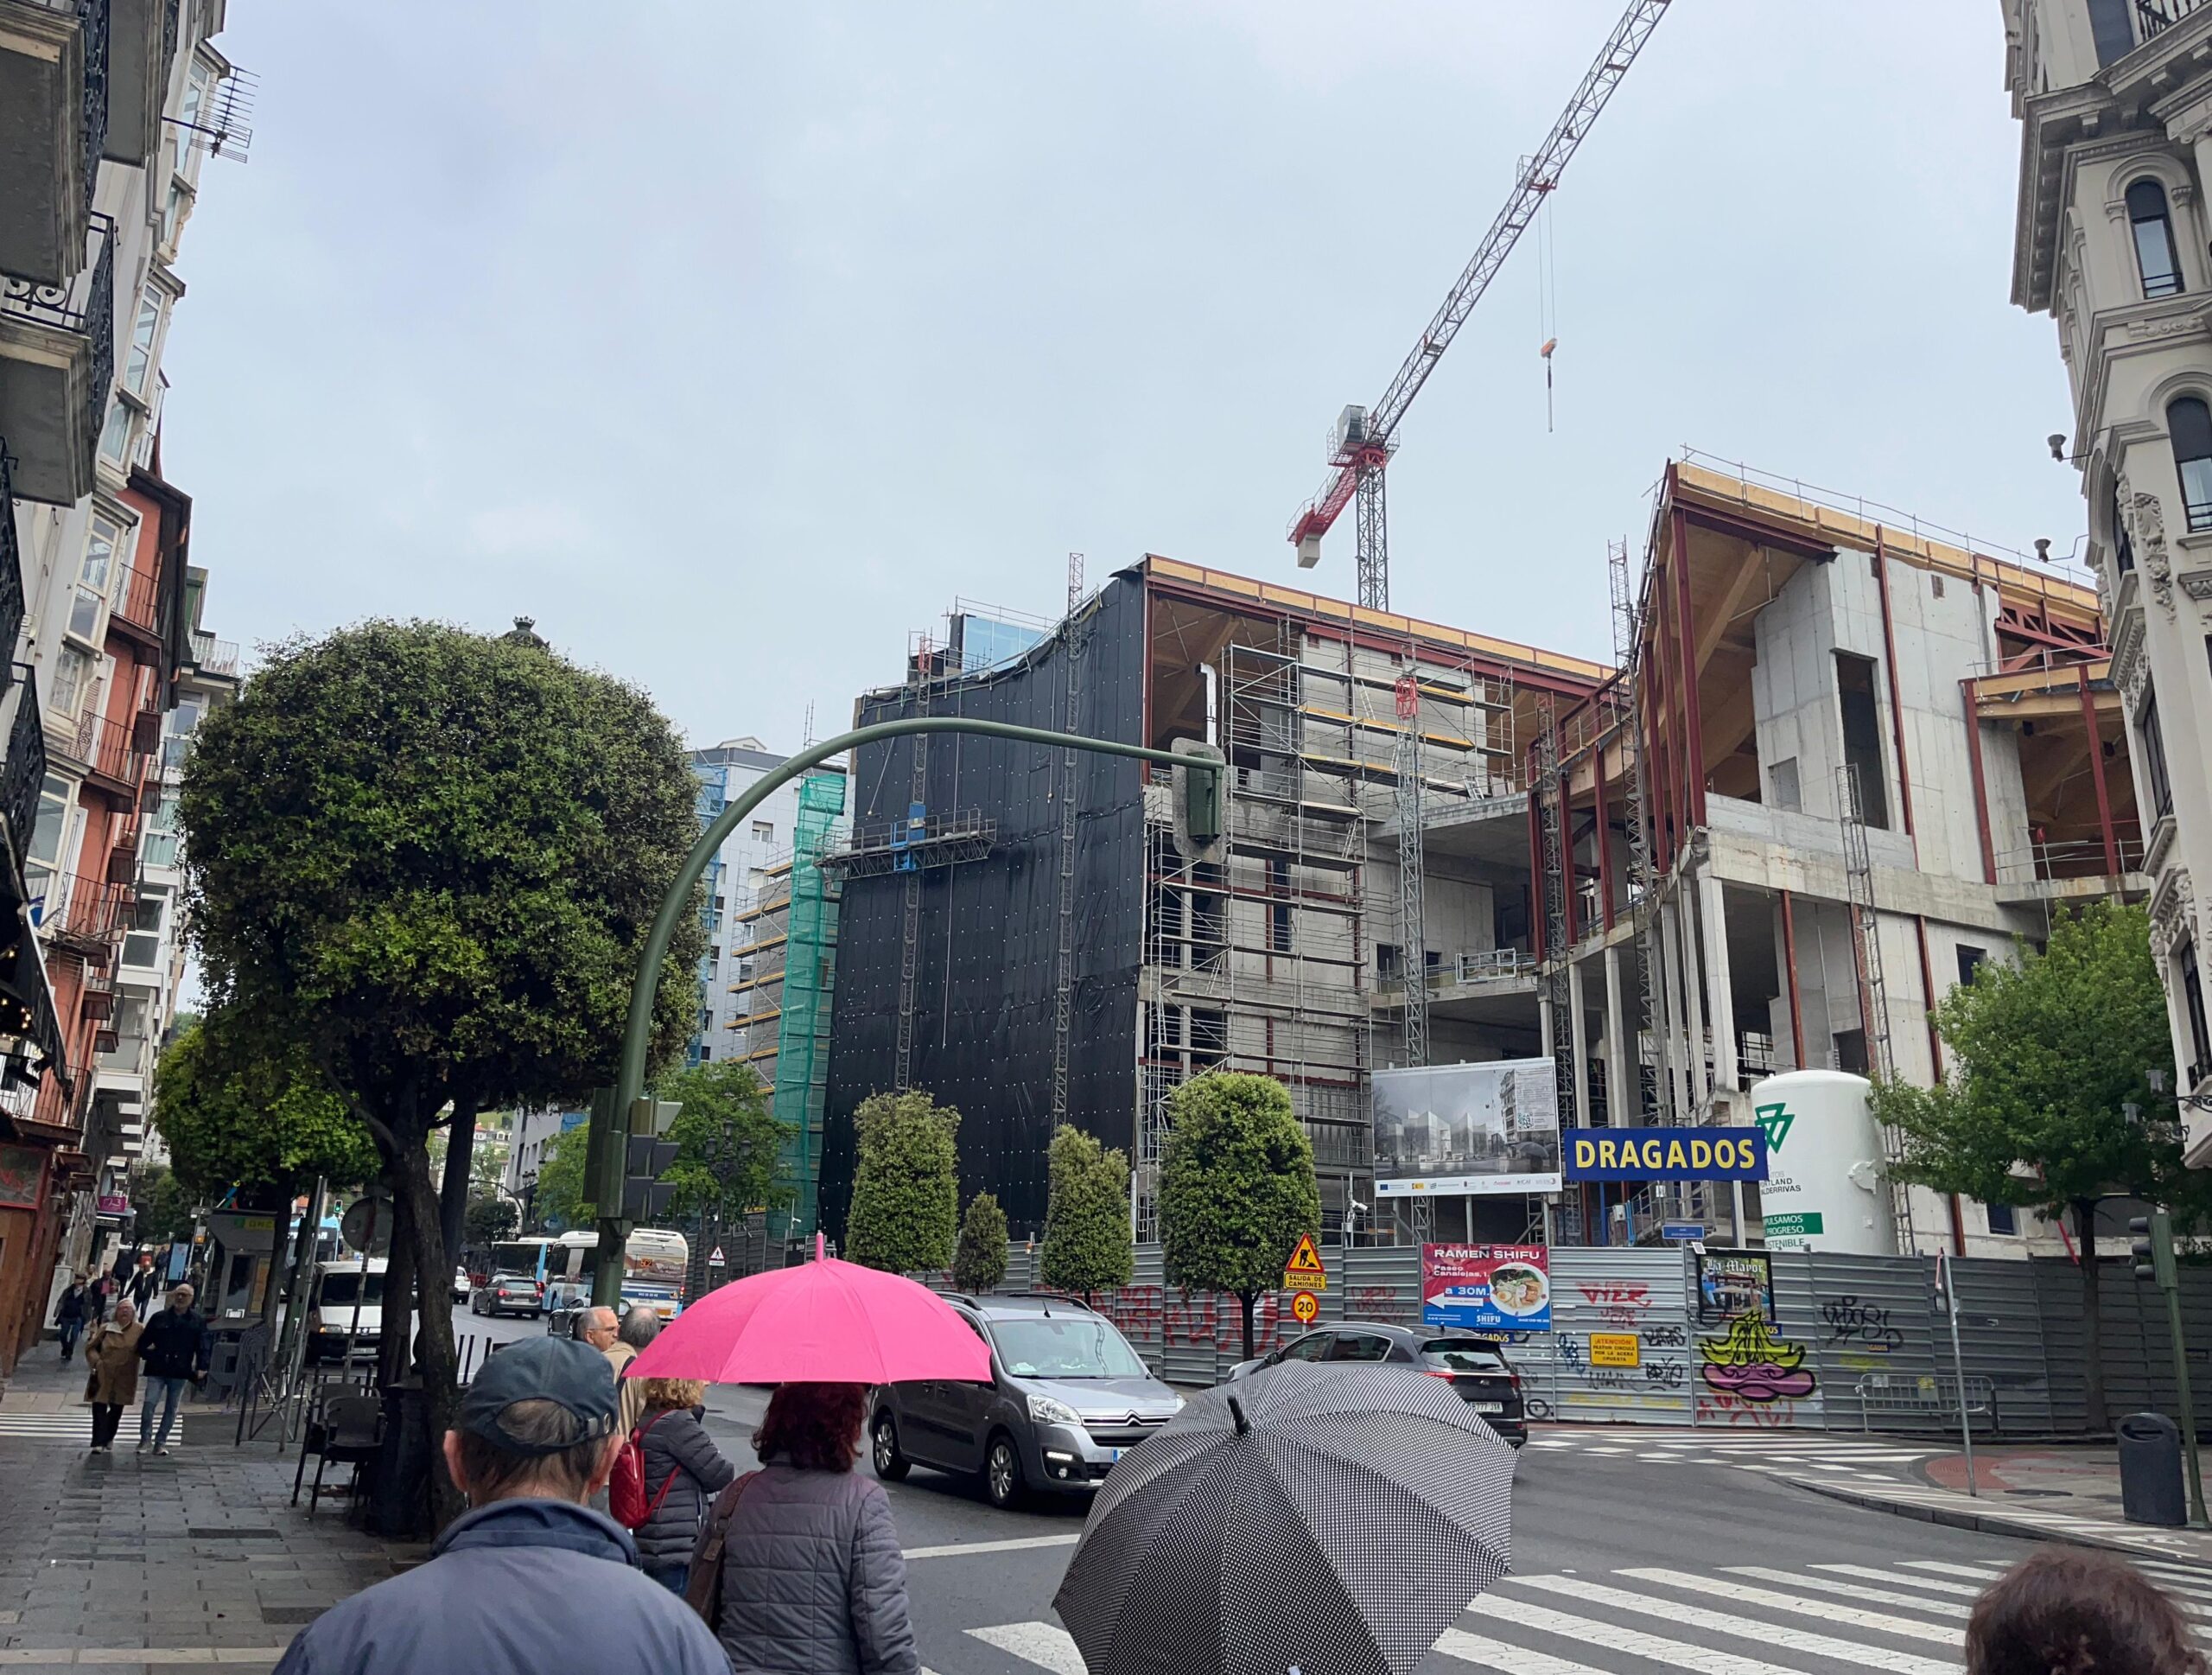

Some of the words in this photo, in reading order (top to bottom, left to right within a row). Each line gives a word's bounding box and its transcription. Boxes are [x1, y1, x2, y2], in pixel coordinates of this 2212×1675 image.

[1575, 1139, 1755, 1169] DRAGADOS
[1434, 1249, 1490, 1259] RAMEN
[1493, 1250, 1540, 1260] SHIFU
[1298, 1301, 1313, 1313] 20
[1477, 1315, 1501, 1323] SHIFU
